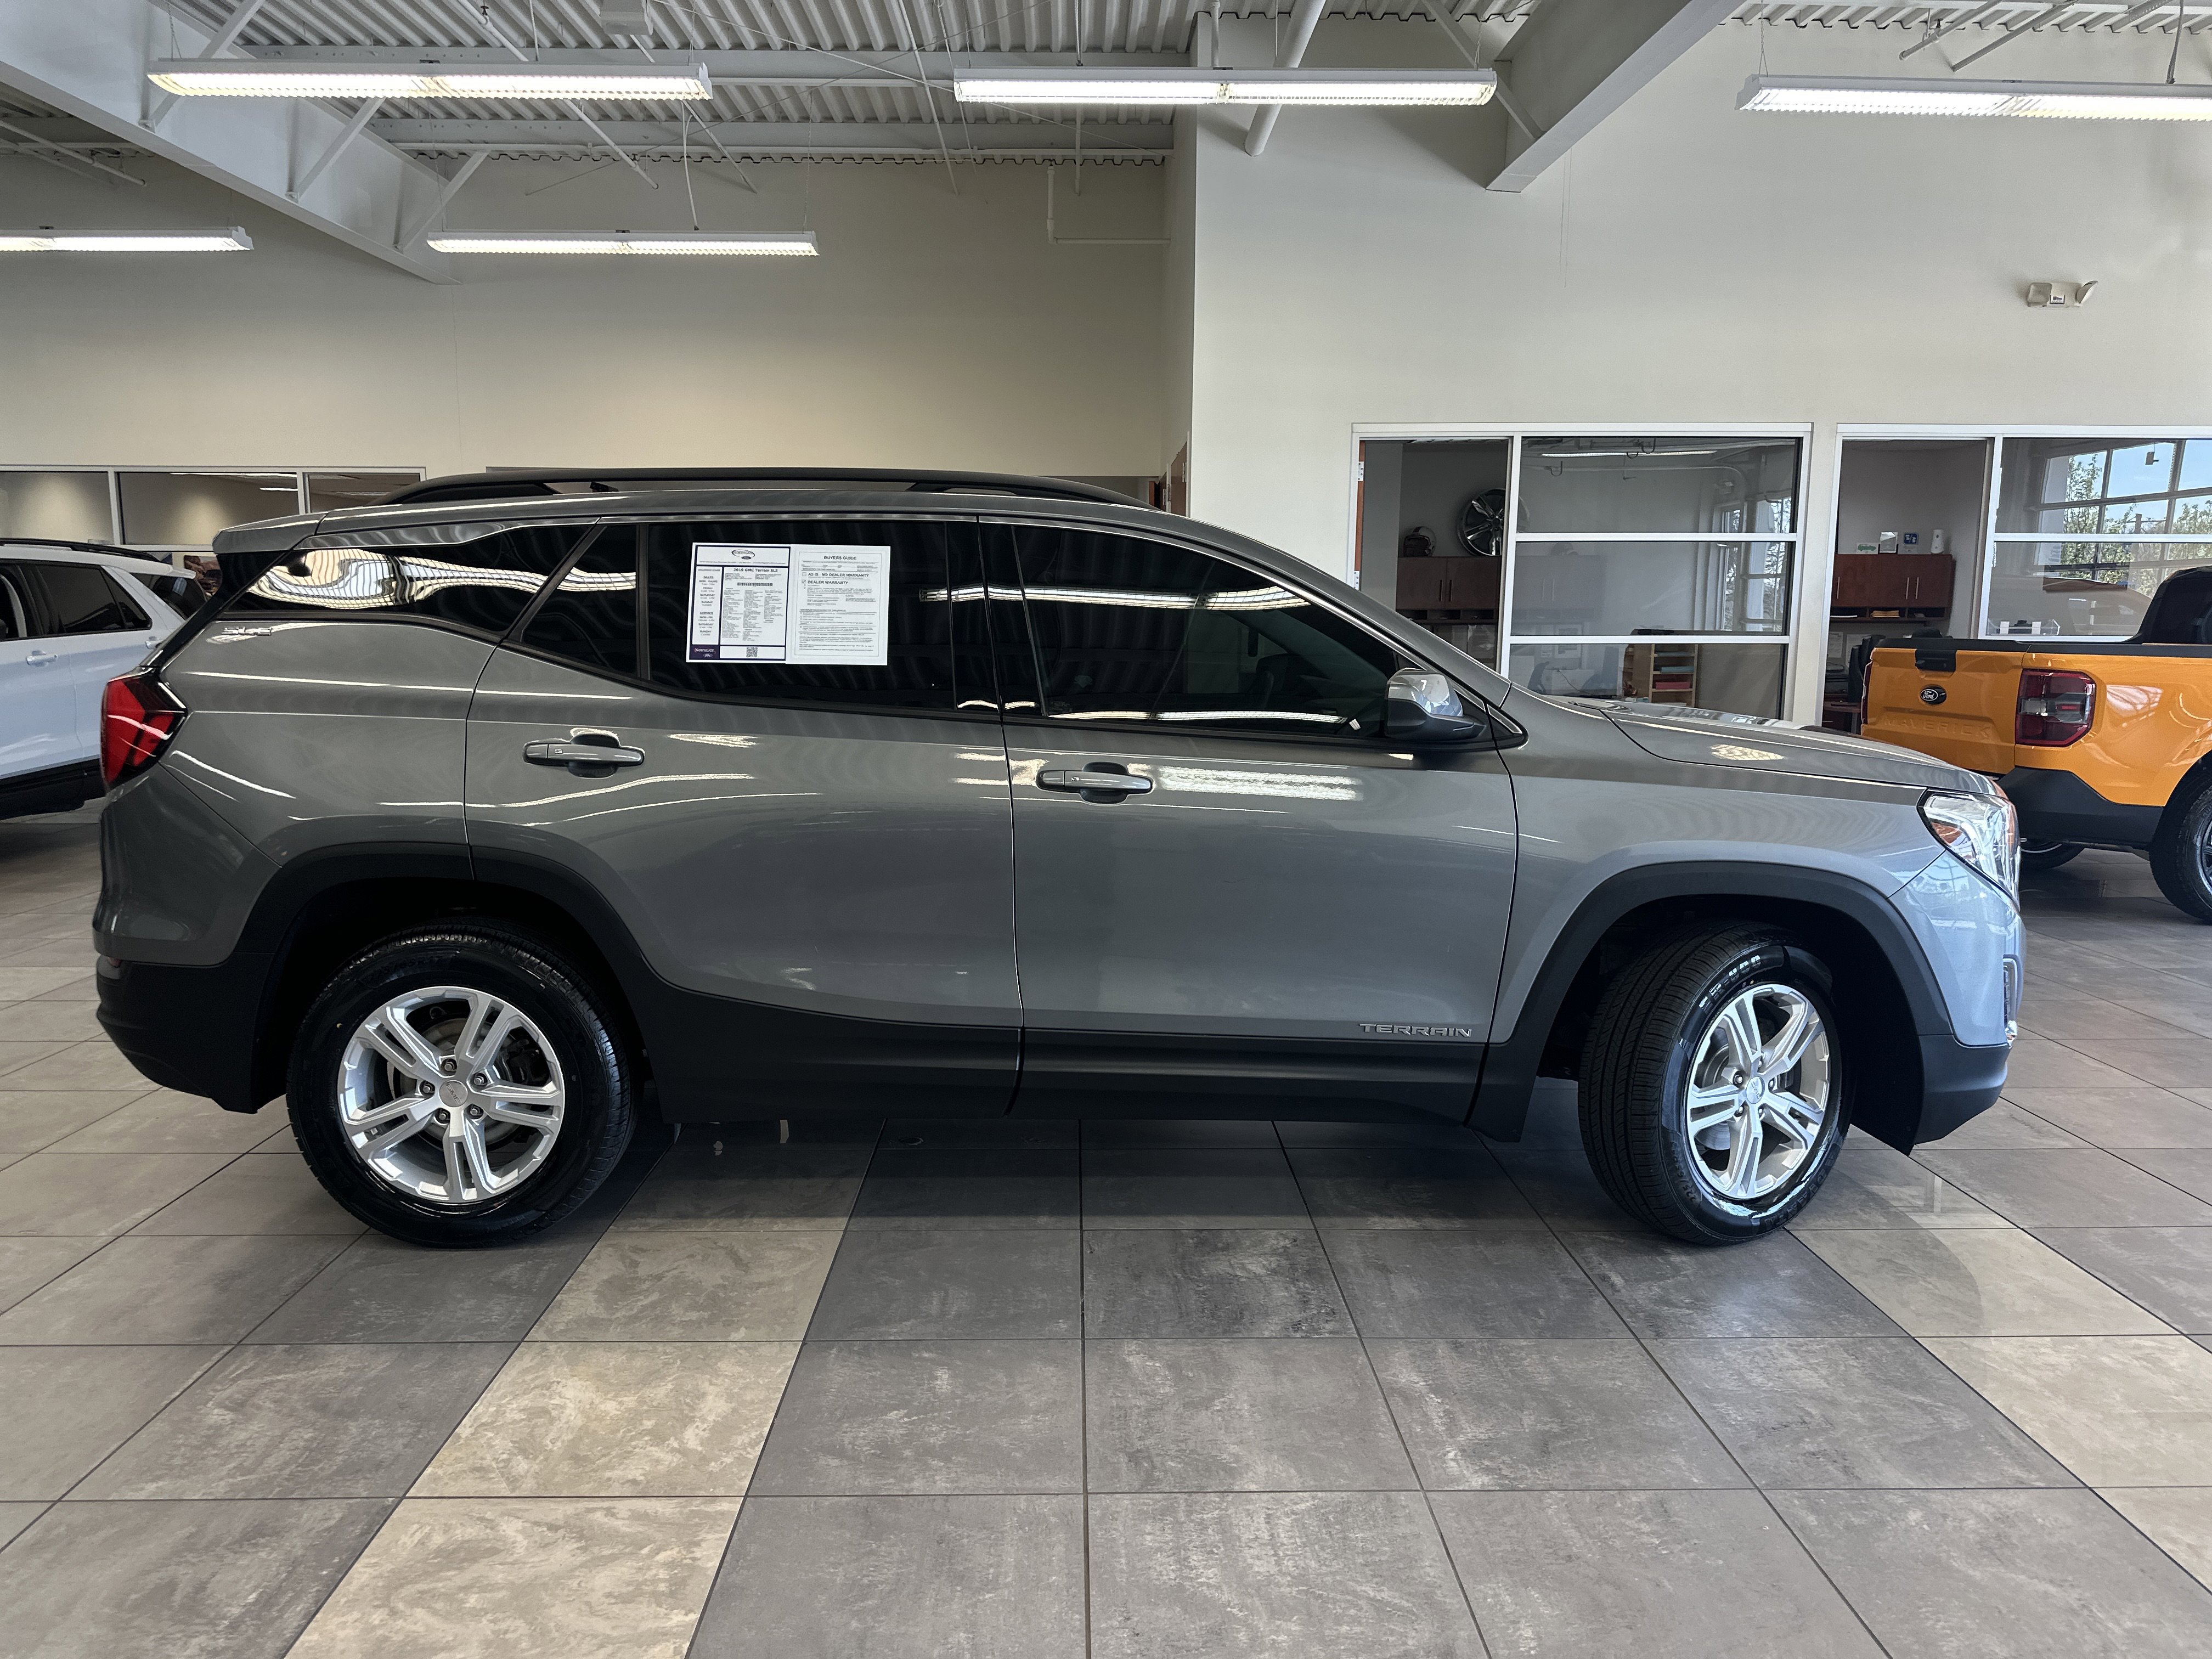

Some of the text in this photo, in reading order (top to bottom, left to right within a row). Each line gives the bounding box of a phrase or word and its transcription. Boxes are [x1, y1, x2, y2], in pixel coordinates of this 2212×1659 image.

[1884, 718, 1992, 738] MAVERICK
[1359, 1023, 1472, 1038] TERRAIN
[445, 1083, 462, 1105] GMC
